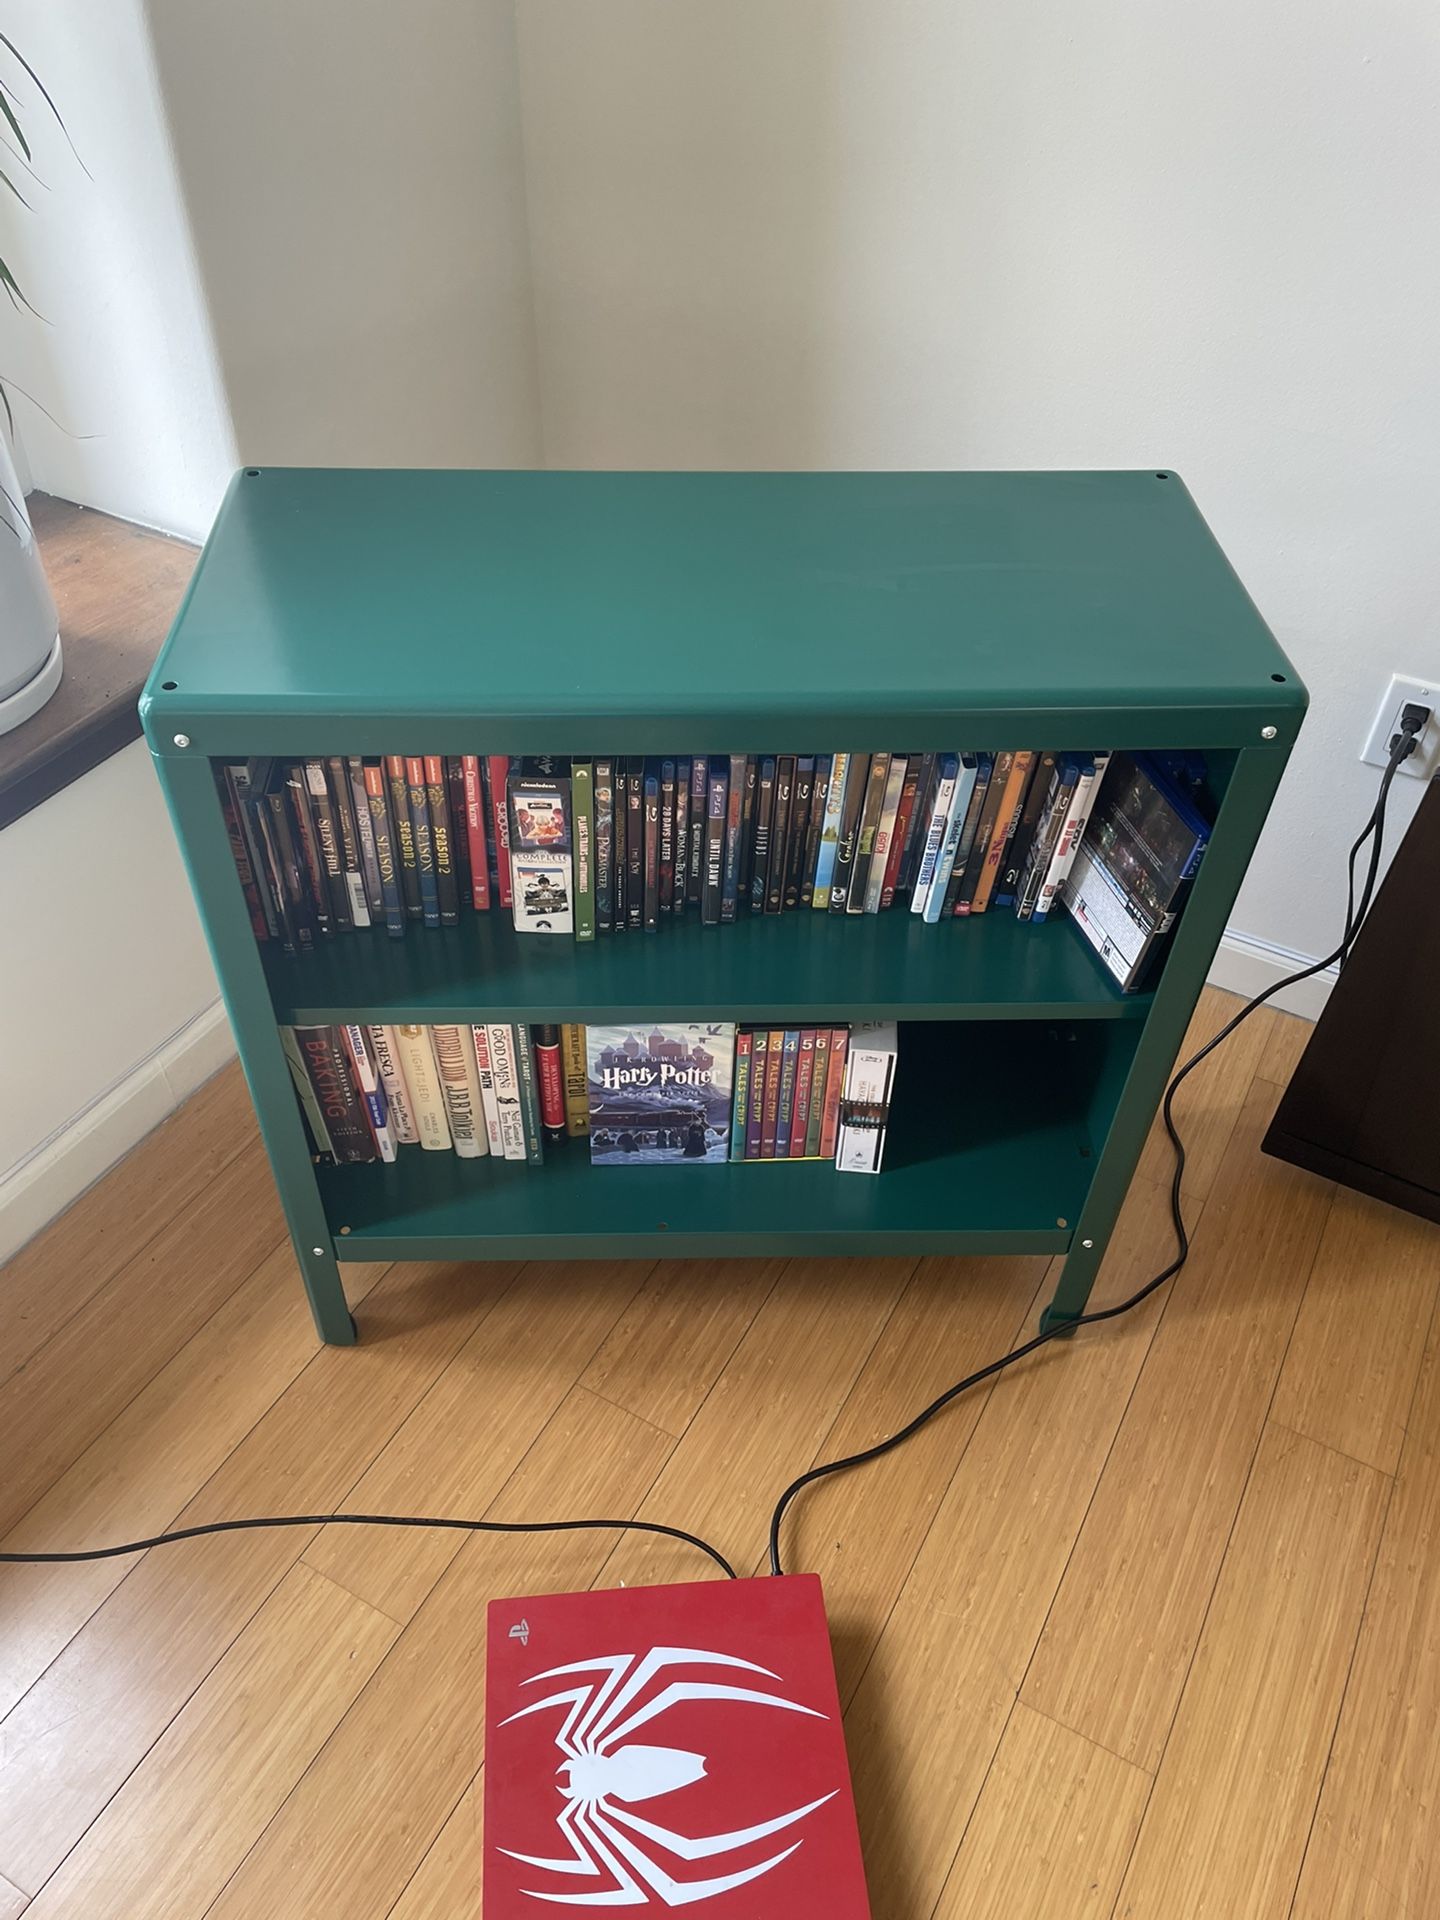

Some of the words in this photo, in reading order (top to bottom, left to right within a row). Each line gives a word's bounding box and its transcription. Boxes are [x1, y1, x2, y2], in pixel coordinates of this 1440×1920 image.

[520, 781, 557, 789] nickelodeon
[662, 806, 673, 817] 28
[932, 814, 945, 828] THE
[317, 818, 336, 854] SILENT
[356, 806, 373, 843] HOSTEL
[496, 801, 510, 849] SCROOGED
[661, 817, 672, 837] DAYS
[400, 820, 415, 861] season
[416, 824, 434, 873] SEASON
[434, 827, 450, 866] season
[661, 837, 671, 861] LATER
[676, 829, 688, 859] WOMAN
[709, 838, 721, 862] UNTIL
[927, 828, 941, 851] BLUES
[376, 835, 395, 883] SEASON
[404, 861, 416, 869] 2
[516, 853, 567, 862] COMPLETE
[918, 851, 937, 886] BROTHERS
[988, 851, 1000, 866] 3
[438, 867, 451, 875] 2
[674, 862, 687, 888] BLACK
[708, 863, 719, 888] DAWN
[475, 1032, 490, 1068] SOLUTION
[492, 1028, 507, 1056] GOOD
[518, 1024, 528, 1056] LANGUAGE
[741, 1044, 750, 1055] 1
[756, 1041, 767, 1051] 2
[772, 1041, 783, 1051] 3
[785, 1041, 796, 1051] 4
[802, 1039, 813, 1050] 5
[816, 1038, 826, 1049] 6
[834, 1039, 845, 1050] 7
[376, 1040, 394, 1077] FRESCA
[432, 1025, 468, 1082] MARILLION
[641, 1055, 708, 1063] ROWLING
[304, 1040, 348, 1118] BAKING
[333, 1048, 353, 1107] PROFESSIONAL
[410, 1049, 424, 1078] LIGHT
[418, 1083, 430, 1104] JEDI
[480, 1070, 493, 1089] PATH
[522, 1061, 531, 1081] TAROT
[602, 1066, 659, 1090] Harry
[660, 1063, 721, 1089] Potter
[737, 1062, 748, 1093] TALES
[754, 1059, 764, 1090] TALES
[769, 1059, 779, 1089] TALES
[783, 1059, 793, 1089] TALES
[800, 1058, 810, 1088] TALES
[814, 1057, 824, 1087] TALES
[736, 1104, 745, 1126] CRYPT
[753, 1102, 762, 1123] CRYPT
[767, 1101, 776, 1122] CRYPT
[781, 1102, 790, 1123] CRYPT
[798, 1100, 807, 1121] CRYPT
[812, 1099, 821, 1120] CRYPT
